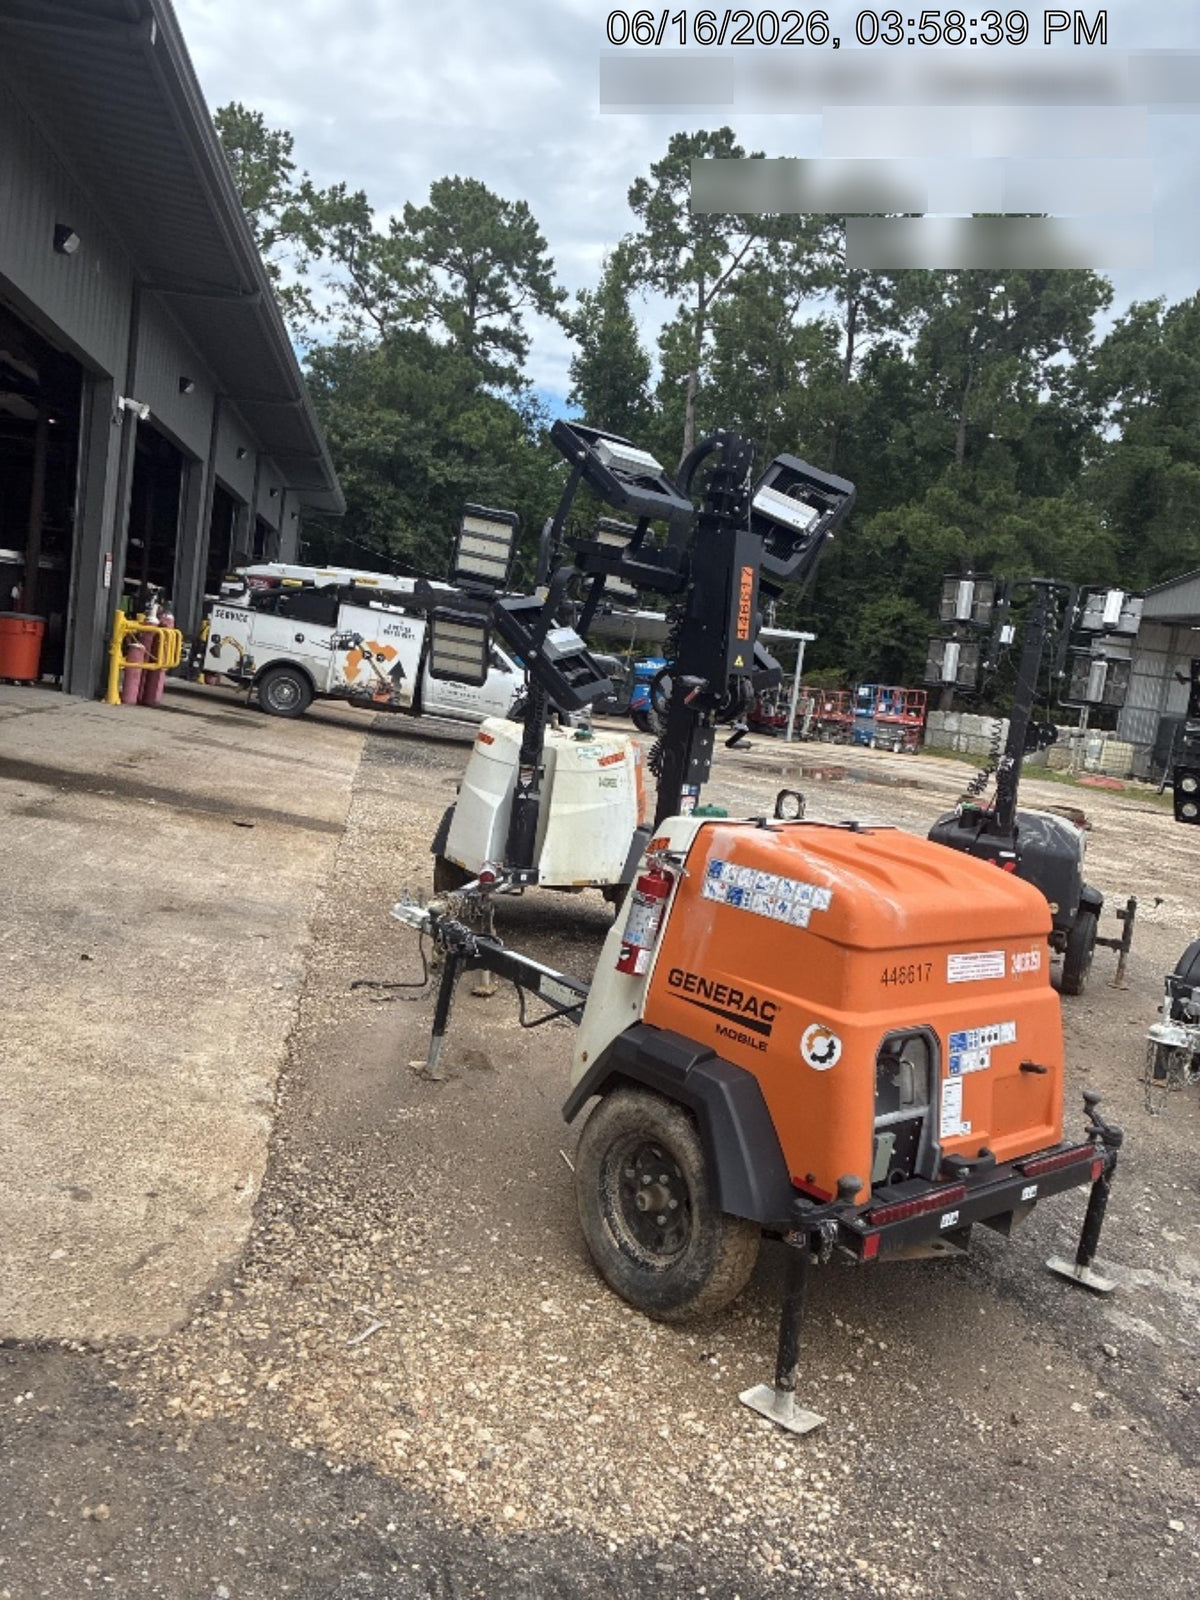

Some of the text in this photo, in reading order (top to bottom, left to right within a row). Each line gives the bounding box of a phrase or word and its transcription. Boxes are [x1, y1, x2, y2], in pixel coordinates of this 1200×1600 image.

[881, 963, 932, 987] 446617
[668, 968, 777, 1023] GENERAC
[715, 1023, 768, 1053] MOBILE
